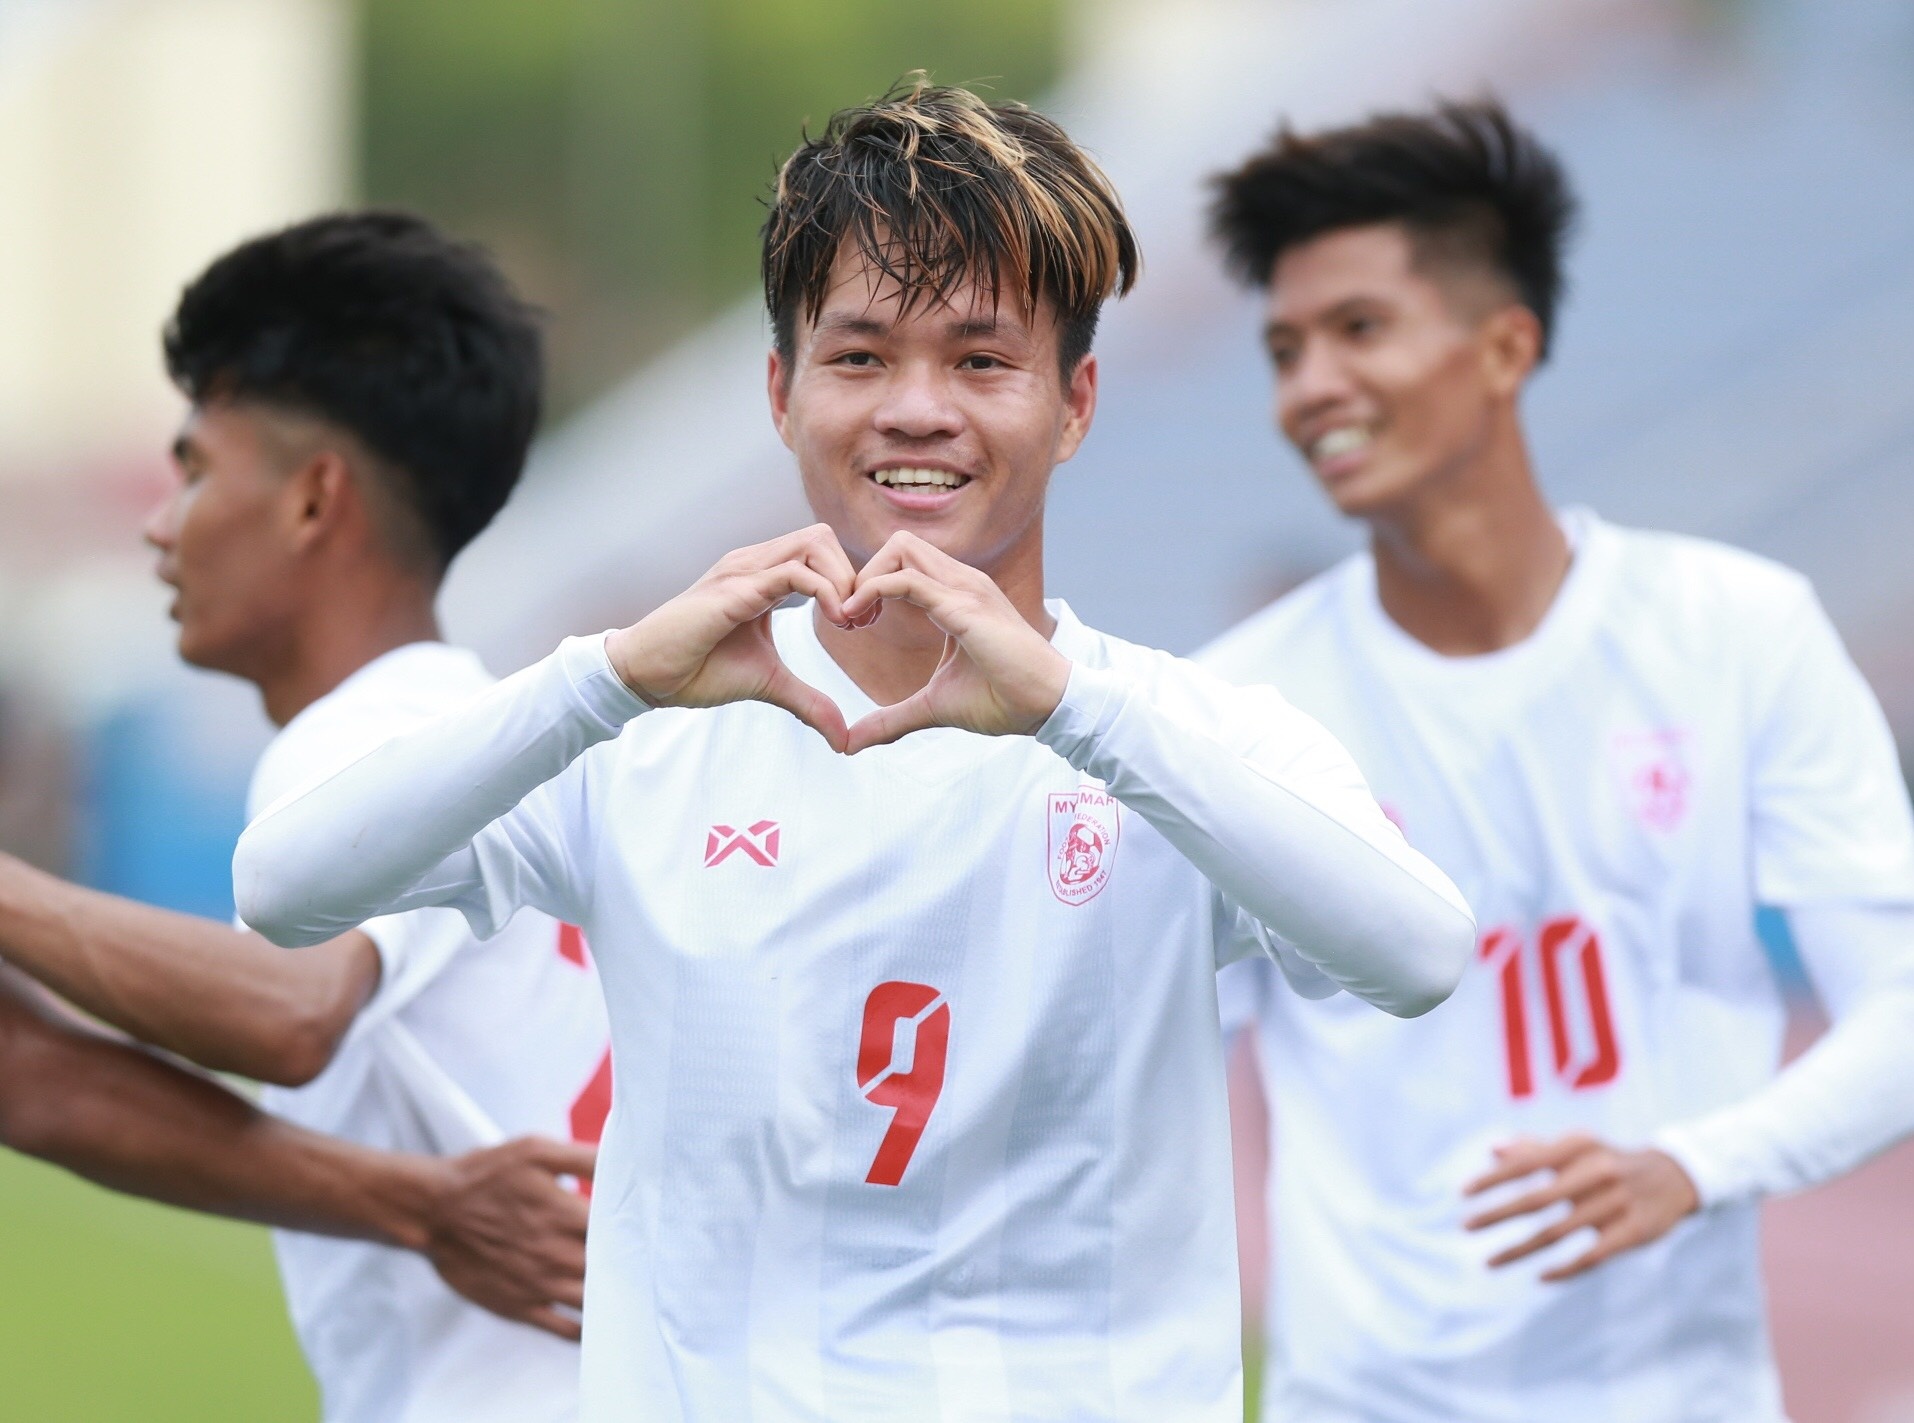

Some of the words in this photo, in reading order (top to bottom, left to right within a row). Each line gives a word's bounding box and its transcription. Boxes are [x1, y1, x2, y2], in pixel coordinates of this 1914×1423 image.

[1094, 870, 1107, 886] 1947
[857, 980, 951, 1187] 9
[1480, 917, 1621, 1098] 10
